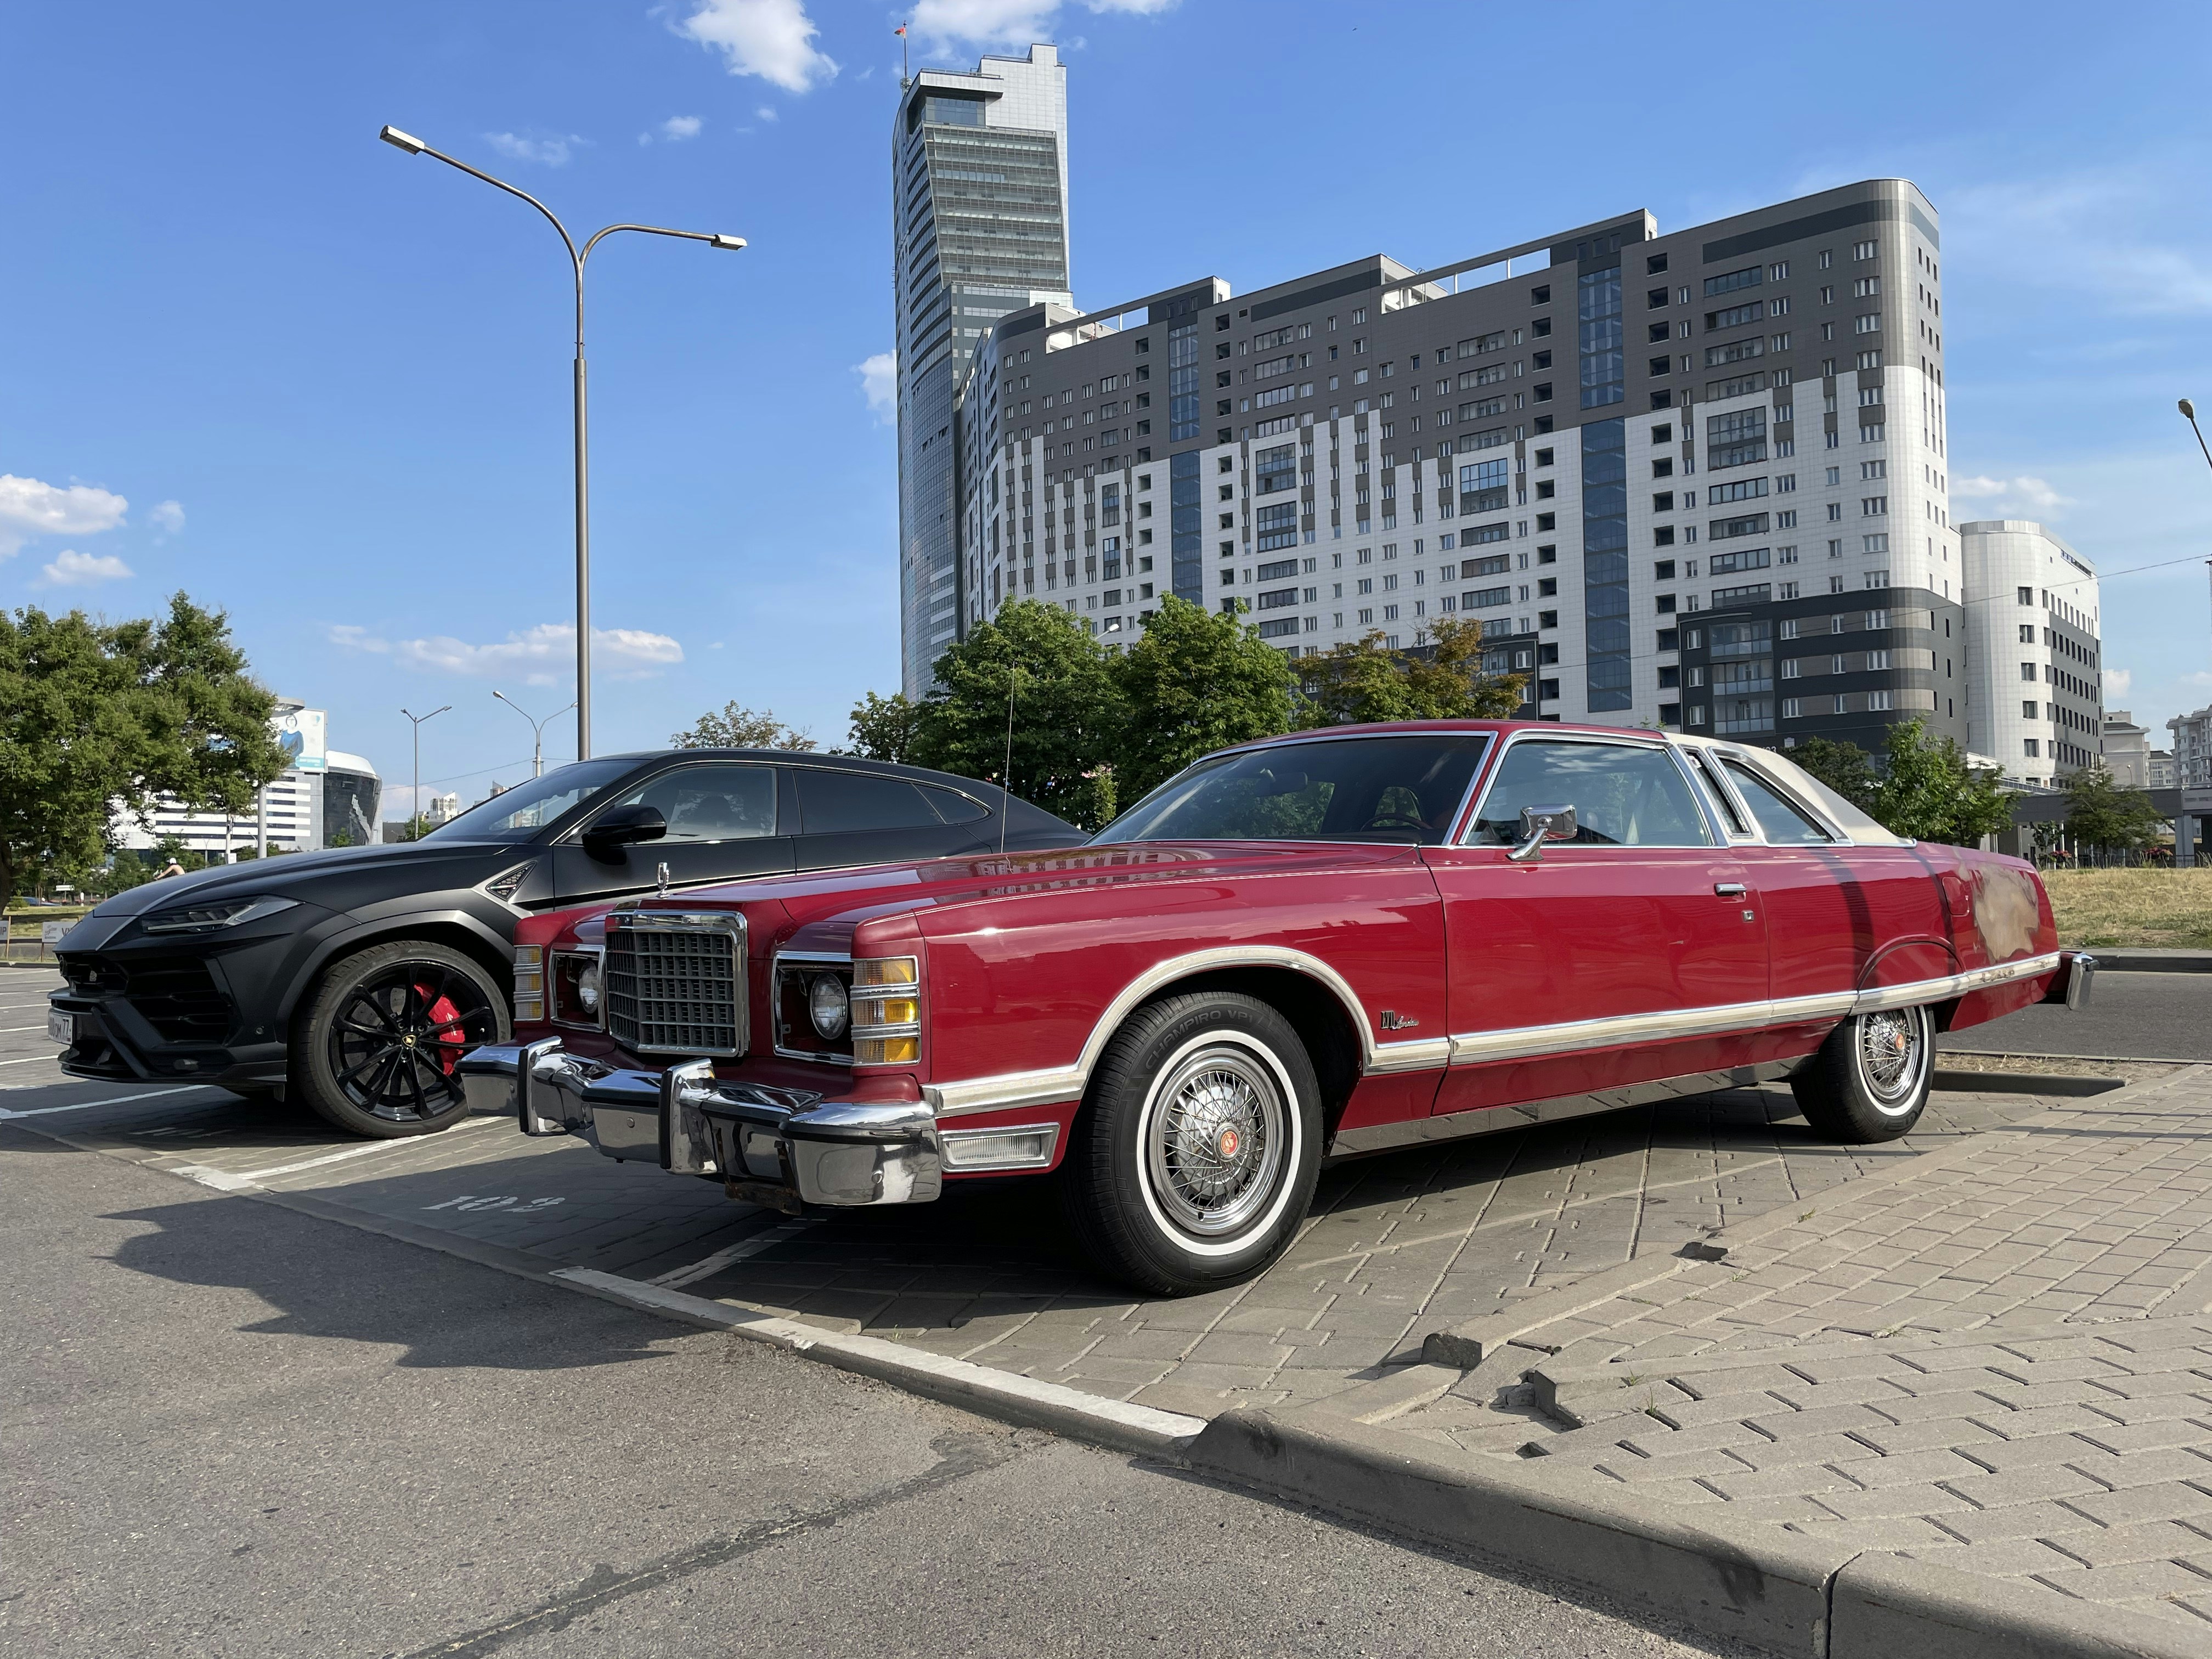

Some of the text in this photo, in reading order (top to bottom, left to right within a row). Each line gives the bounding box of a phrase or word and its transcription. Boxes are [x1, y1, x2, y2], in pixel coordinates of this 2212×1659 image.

[63, 1019, 69, 1035] 77
[1146, 1009, 1253, 1070] CHAMPIRO VP1
[1137, 1213, 1154, 1244] RADIAL
